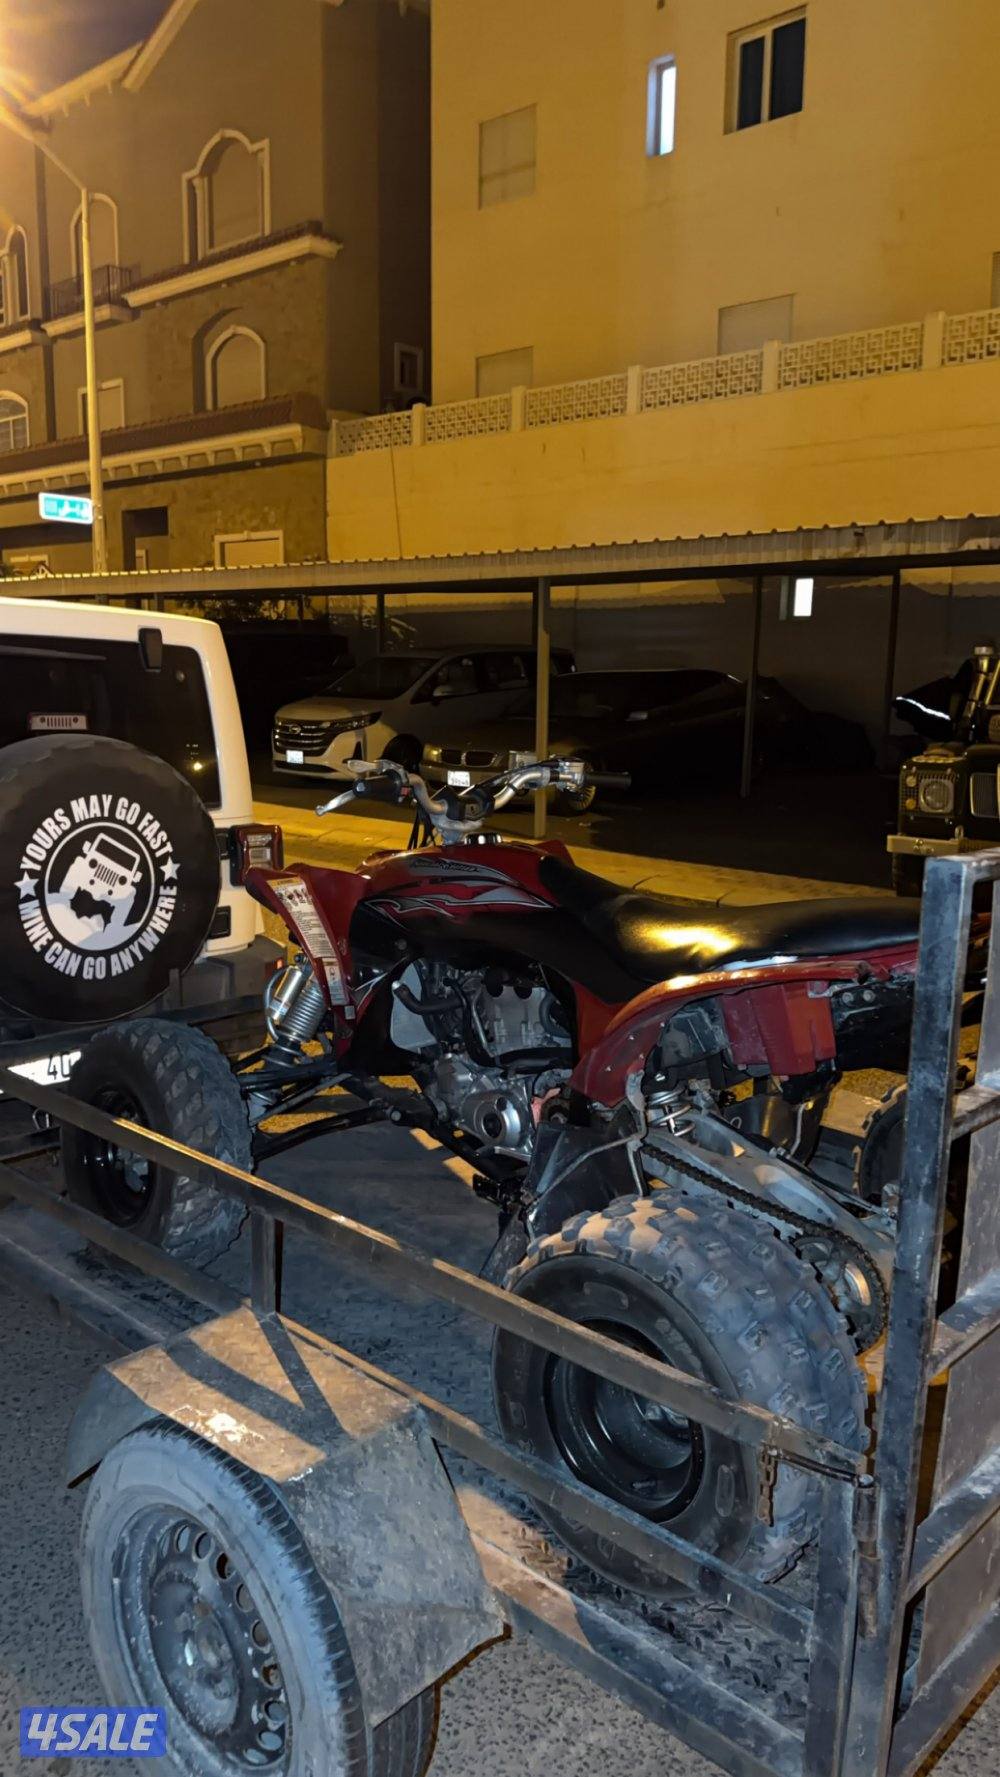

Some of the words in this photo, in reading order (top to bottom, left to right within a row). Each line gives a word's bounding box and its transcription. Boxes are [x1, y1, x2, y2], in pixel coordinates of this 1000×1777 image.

[20, 808, 72, 870] YOURS
[70, 794, 113, 823] MAY
[115, 797, 141, 825] GO
[137, 813, 173, 858] FAST
[19, 900, 54, 952] MINE
[44, 941, 82, 977] CAN
[82, 956, 107, 980] GO
[110, 885, 178, 977] ANYWHERE
